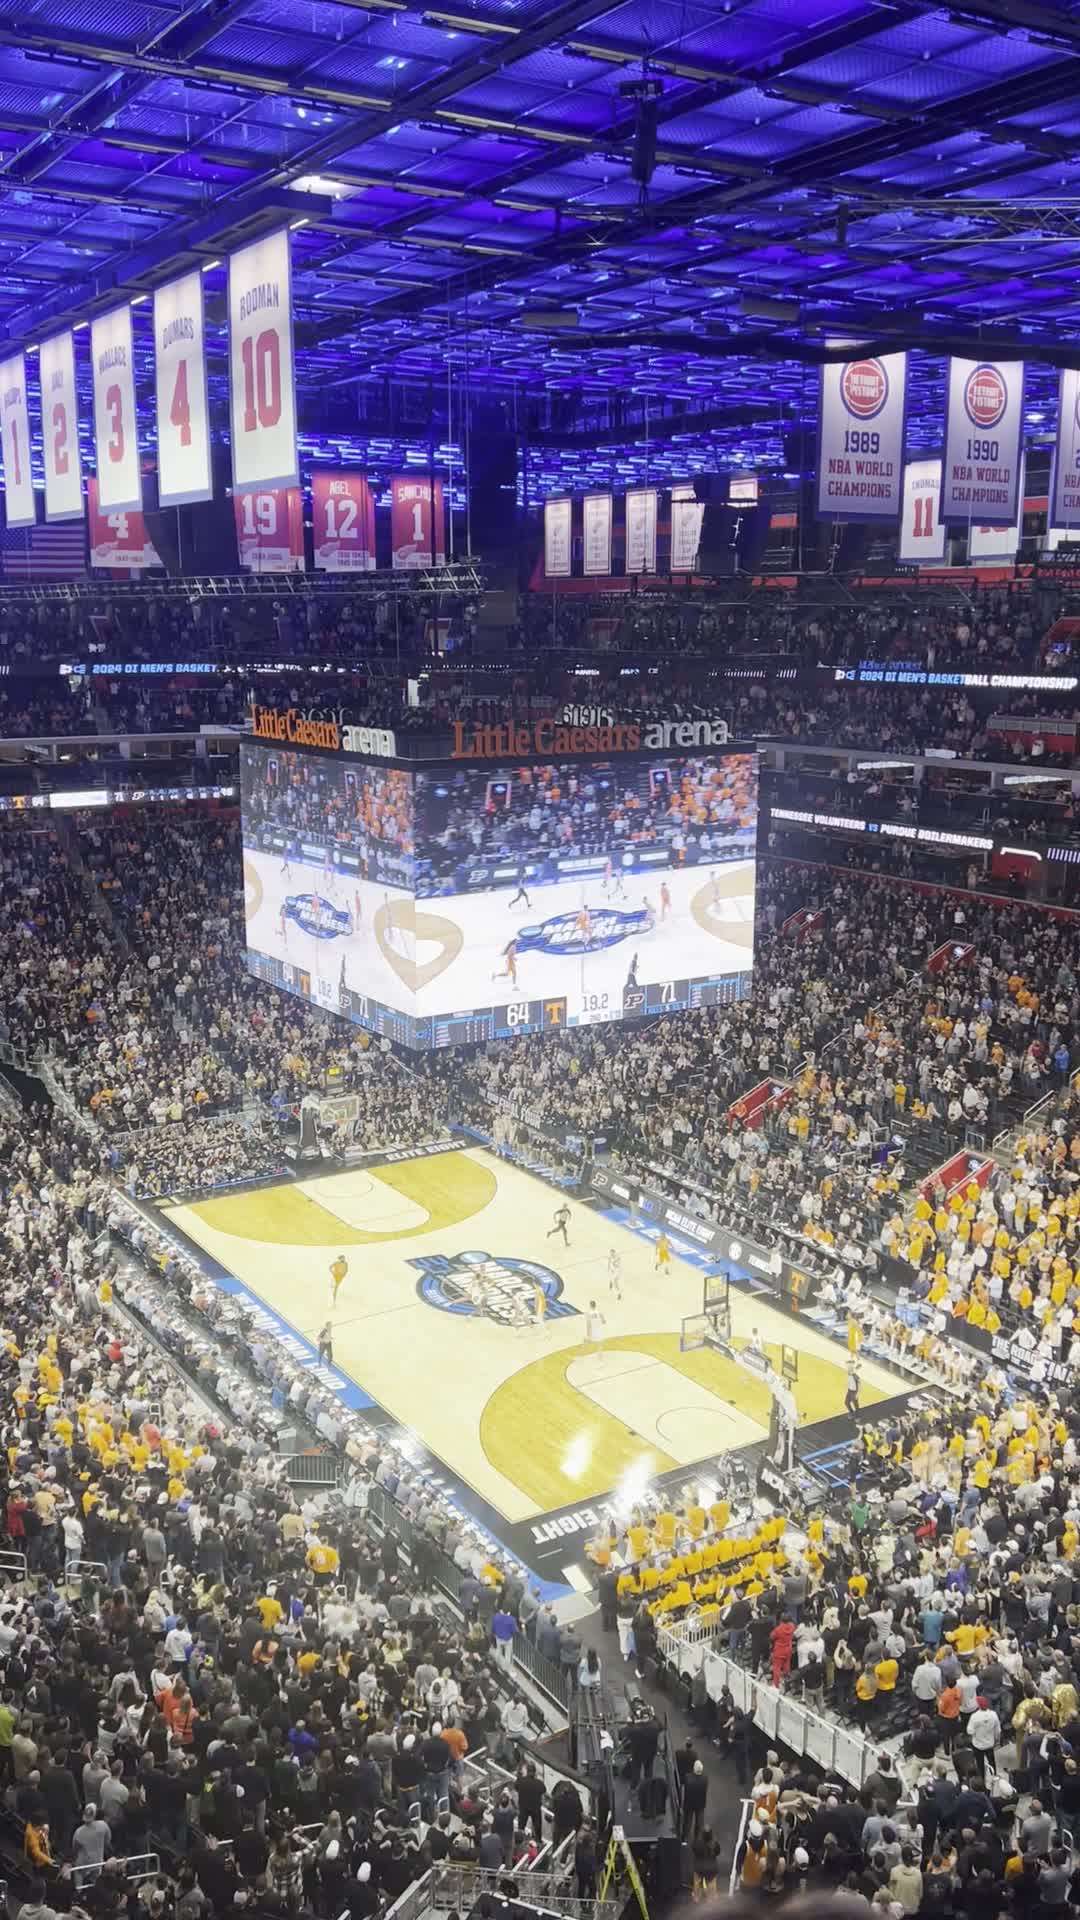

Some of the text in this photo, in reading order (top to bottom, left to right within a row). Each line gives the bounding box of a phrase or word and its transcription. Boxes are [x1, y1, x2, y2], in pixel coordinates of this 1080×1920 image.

[240, 283, 280, 320] RODMAN
[163, 317, 194, 350] DUMARS
[242, 328, 281, 433] 10
[170, 360, 192, 446] 4
[52, 403, 69, 475] 2
[106, 384, 124, 463] 3
[844, 431, 880, 454] 1989
[11, 419, 22, 485] 1
[828, 459, 893, 477] NBA WORLD
[966, 439, 999, 462] 1990
[828, 481, 891, 498] CHAMPIONS
[952, 465, 1010, 484] NBA WORLD
[242, 493, 277, 535] 19
[952, 486, 1009, 504] CHAMPIONS
[108, 511, 129, 539] 4
[324, 500, 359, 539] 12
[411, 503, 425, 541] 1
[912, 496, 934, 538] 11
[92, 664, 122, 674] 2024
[140, 663, 173, 673] MEN'S
[859, 671, 884, 681] 2024
[897, 672, 927, 683] MEN'S
[928, 673, 990, 687] BASKETBALL
[990, 674, 1079, 690] CHAMPIONSHIP
[250, 704, 286, 739] Little
[285, 708, 340, 750] Caesars
[342, 725, 397, 757] arena
[451, 717, 729, 759] Little Caesars arena
[770, 808, 814, 823] TENNESSEE
[814, 814, 866, 831] VOLUNTEERS
[880, 823, 917, 839] PURDUE
[917, 829, 994, 850] BOILERMAKERS
[506, 1003, 530, 1027] 64
[545, 1000, 565, 1024] T
[581, 993, 609, 1012] 19.2
[660, 981, 677, 1004] 71
[530, 1508, 600, 1545] EIGHT
